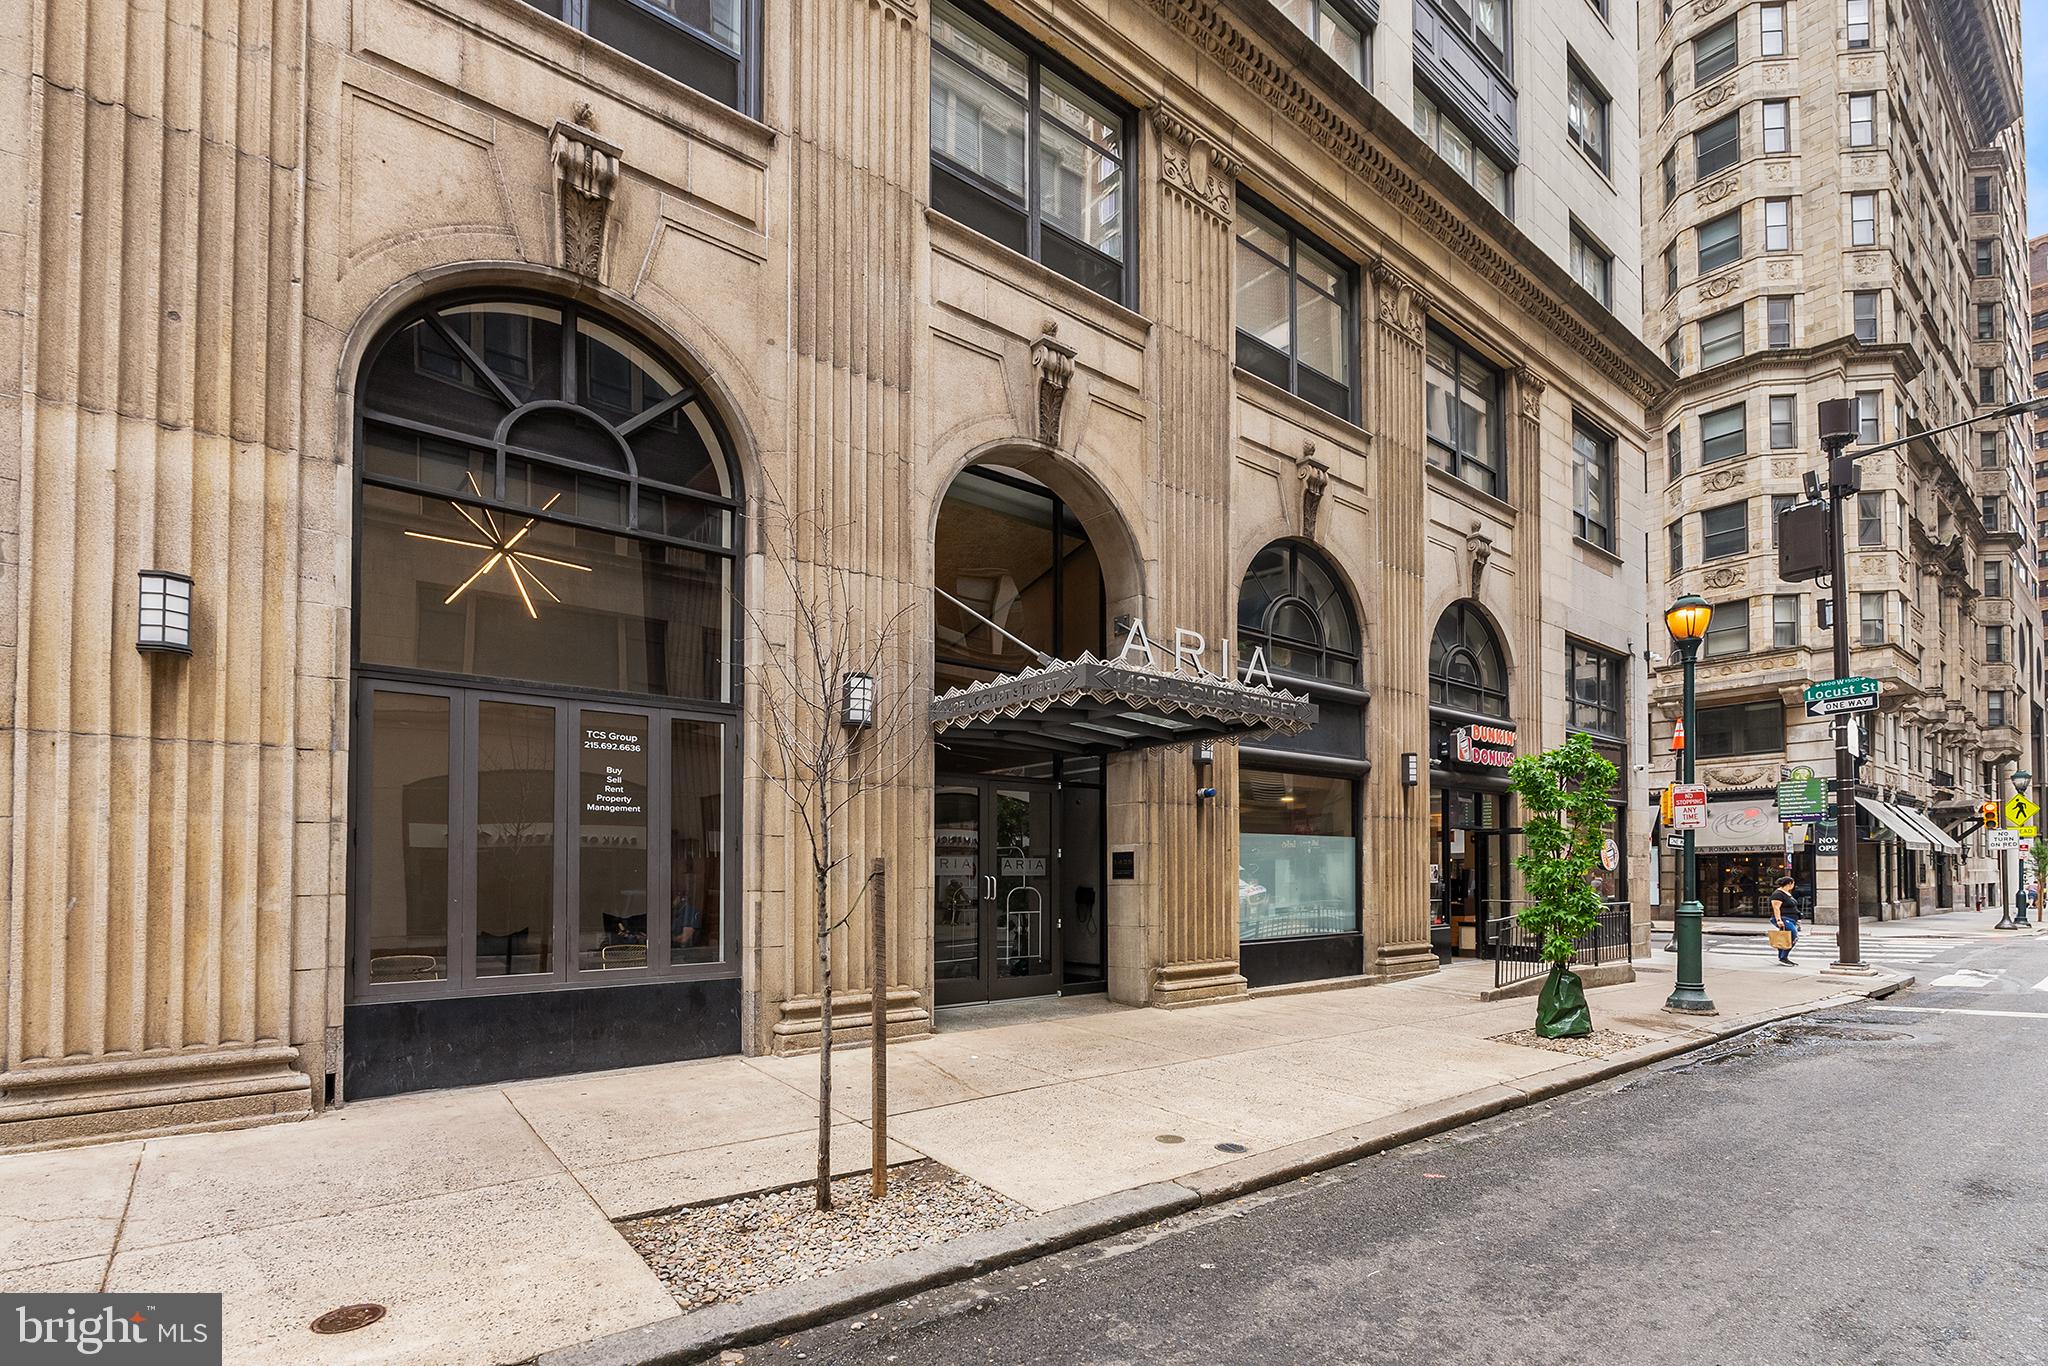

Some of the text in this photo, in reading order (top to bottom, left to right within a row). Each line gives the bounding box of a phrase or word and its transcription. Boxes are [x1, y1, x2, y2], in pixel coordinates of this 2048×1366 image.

[1120, 618, 1273, 688] ARIA
[1115, 671, 1297, 717] 1425 LOCUST STREET
[1807, 682, 1876, 700] Locust St
[1825, 698, 1869, 710] ONE WAY
[586, 730, 638, 743] TCS Group
[1471, 724, 1518, 746] DUNKIN'
[584, 741, 641, 752] 215.692.6636
[1472, 747, 1515, 767] DONUTS
[606, 766, 623, 775] Buy
[606, 776, 622, 784] Sell
[604, 785, 624, 793] Rent
[596, 794, 632, 804] Property
[586, 803, 641, 813] Management
[1682, 806, 1698, 814] ANY
[1818, 844, 1838, 852] OPE
[939, 858, 972, 869] RIA
[1003, 859, 1044, 870] ARIA
